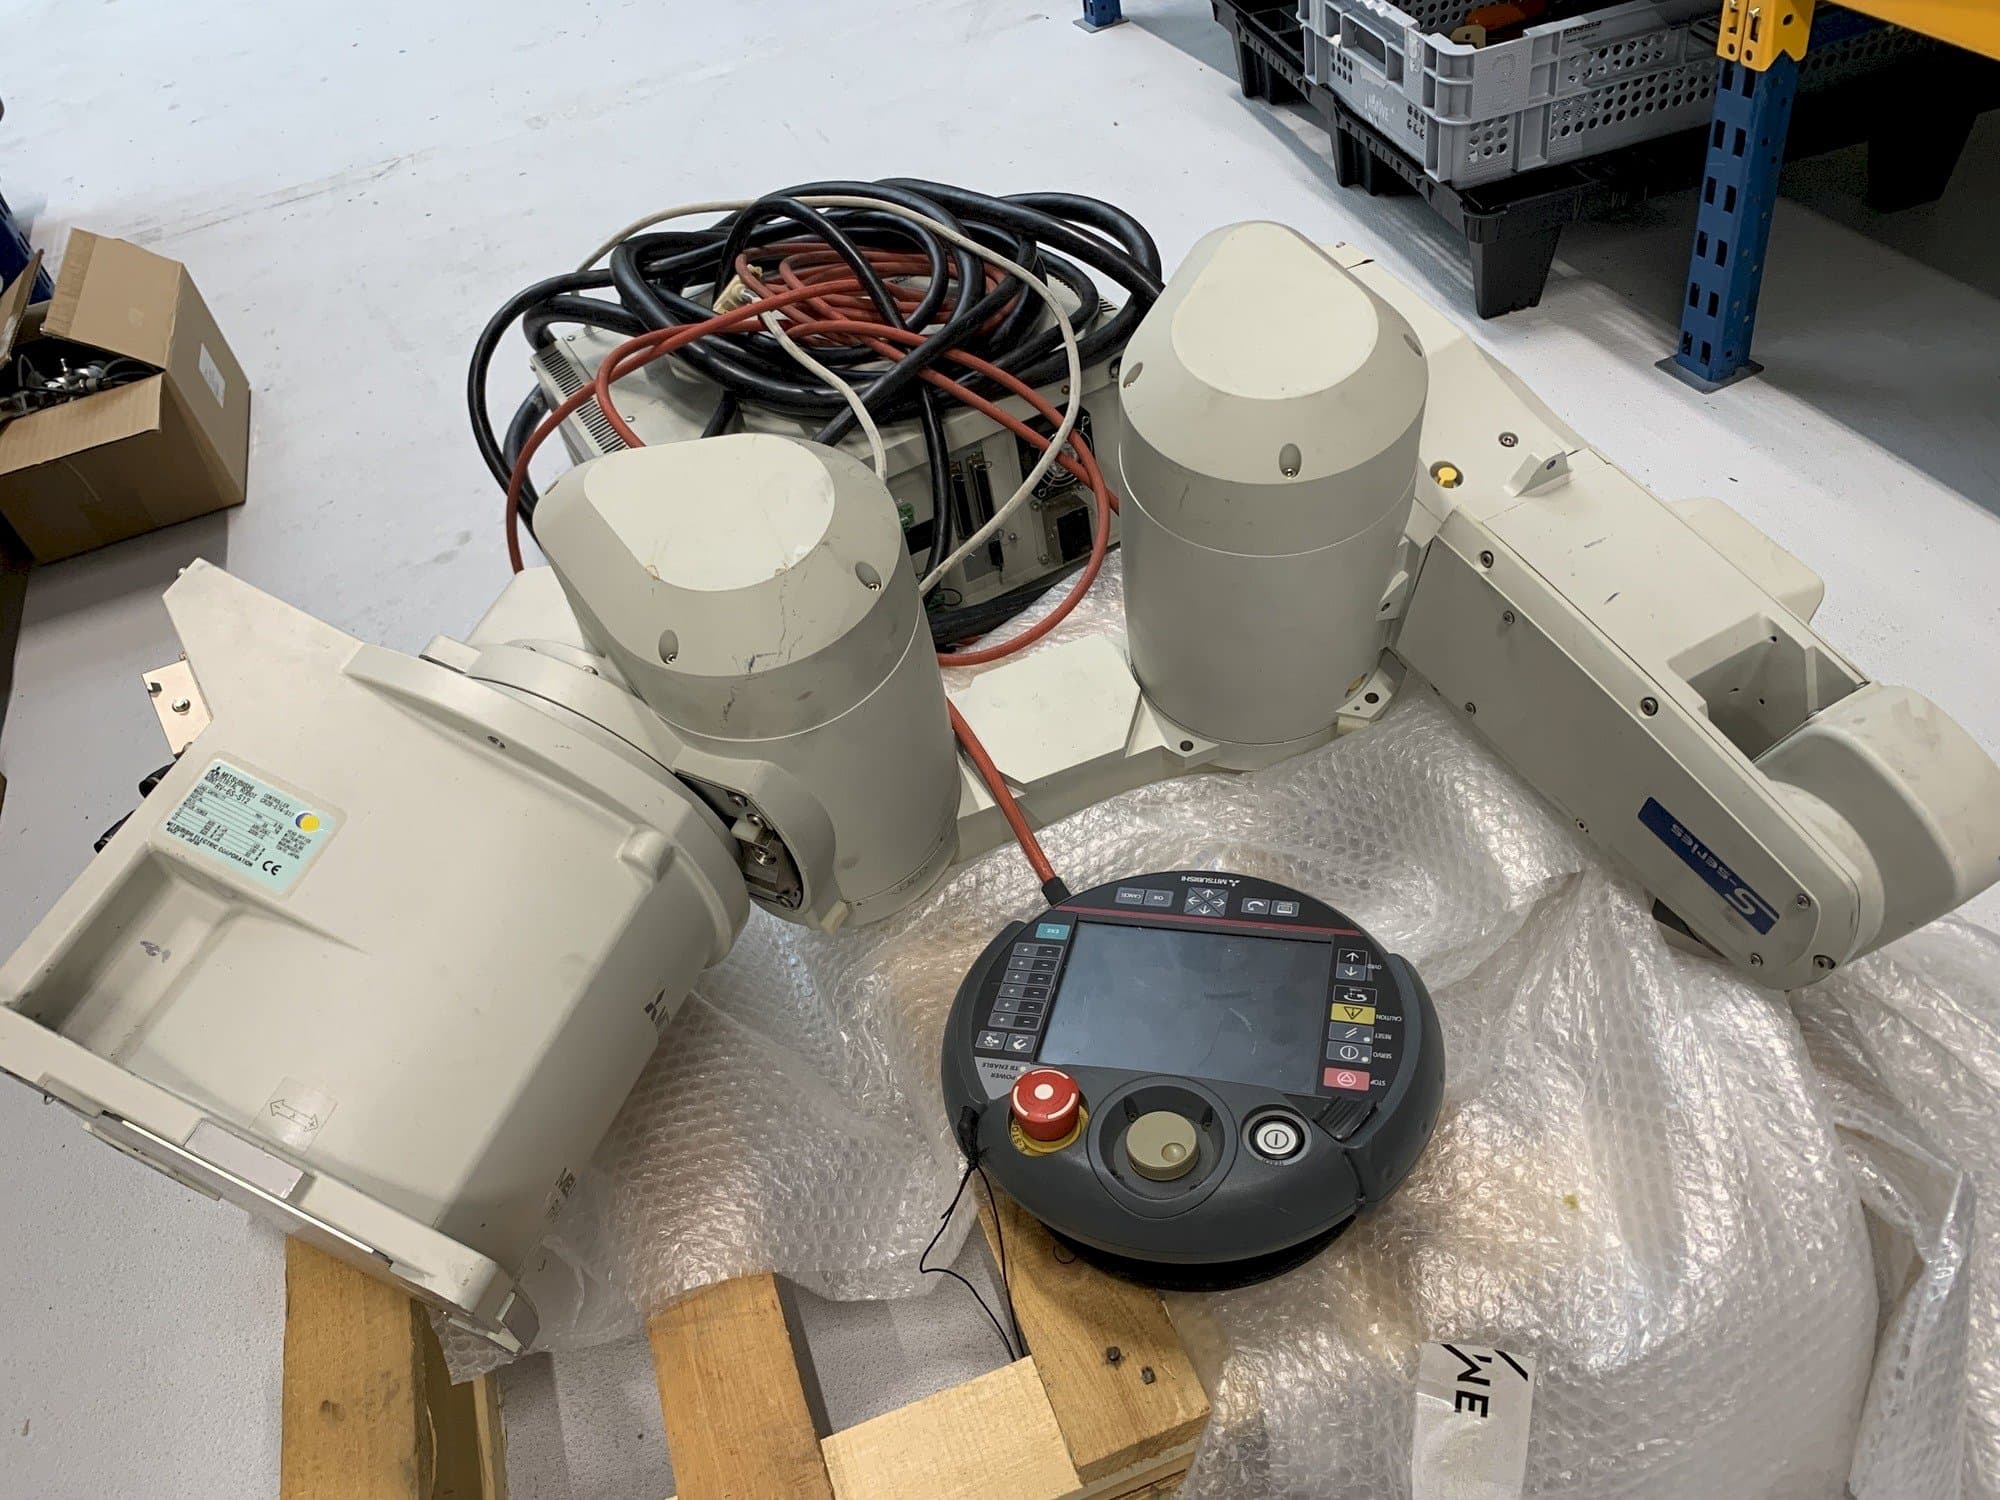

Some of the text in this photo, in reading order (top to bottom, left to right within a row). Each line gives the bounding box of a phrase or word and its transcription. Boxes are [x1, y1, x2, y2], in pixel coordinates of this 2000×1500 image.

[1181, 876, 1227, 885] MITSUBISHI
[1376, 1013, 1402, 1022] CAUTION
[982, 1062, 1008, 1070] ENABLE
[991, 1072, 1017, 1080] POWER
[1370, 1079, 1386, 1087] STOP
